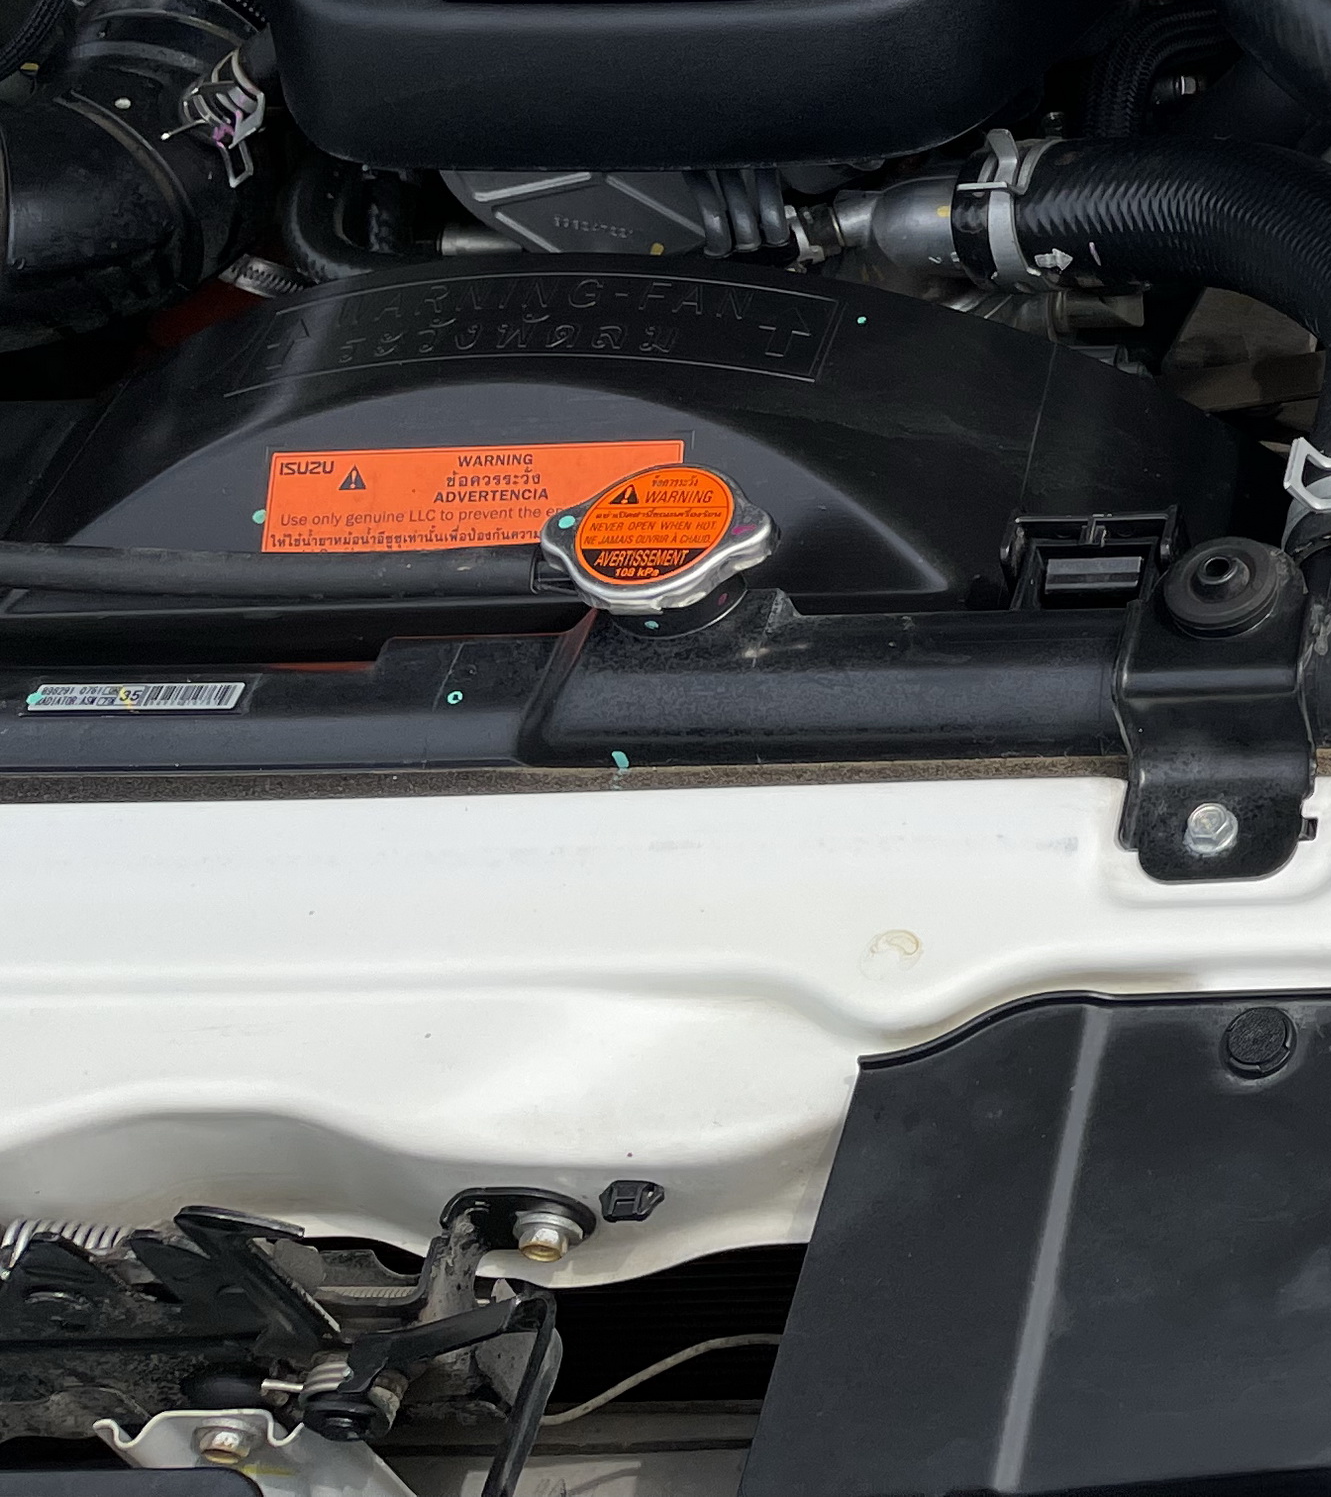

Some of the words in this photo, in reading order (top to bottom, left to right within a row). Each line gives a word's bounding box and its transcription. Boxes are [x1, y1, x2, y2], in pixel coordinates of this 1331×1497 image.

[338, 315, 681, 365] ระวังพัดลม
[458, 454, 533, 467] WARNING
[280, 461, 334, 475] ISUZU
[446, 467, 540, 488] ข้อควรระวัง
[434, 489, 548, 503] ADVERTENCIA
[645, 490, 713, 503] WARNING
[280, 514, 307, 526] Use
[312, 512, 340, 527] only
[345, 511, 404, 527] genuine
[410, 509, 436, 521] LLC
[440, 509, 454, 521] to
[458, 509, 514, 523] prevent
[518, 506, 542, 518] the
[590, 522, 624, 532] NEVER
[628, 521, 656, 531] OPEN
[660, 521, 693, 530] WHEN
[584, 536, 597, 544] NE
[599, 535, 633, 545] JAMAIS
[635, 535, 669, 544] OUVRIR
[670, 532, 678, 543] À
[593, 550, 690, 566] AVERTISSEMENT
[615, 568, 636, 577] 108
[638, 567, 659, 577] kPa
[119, 689, 143, 702] 35
